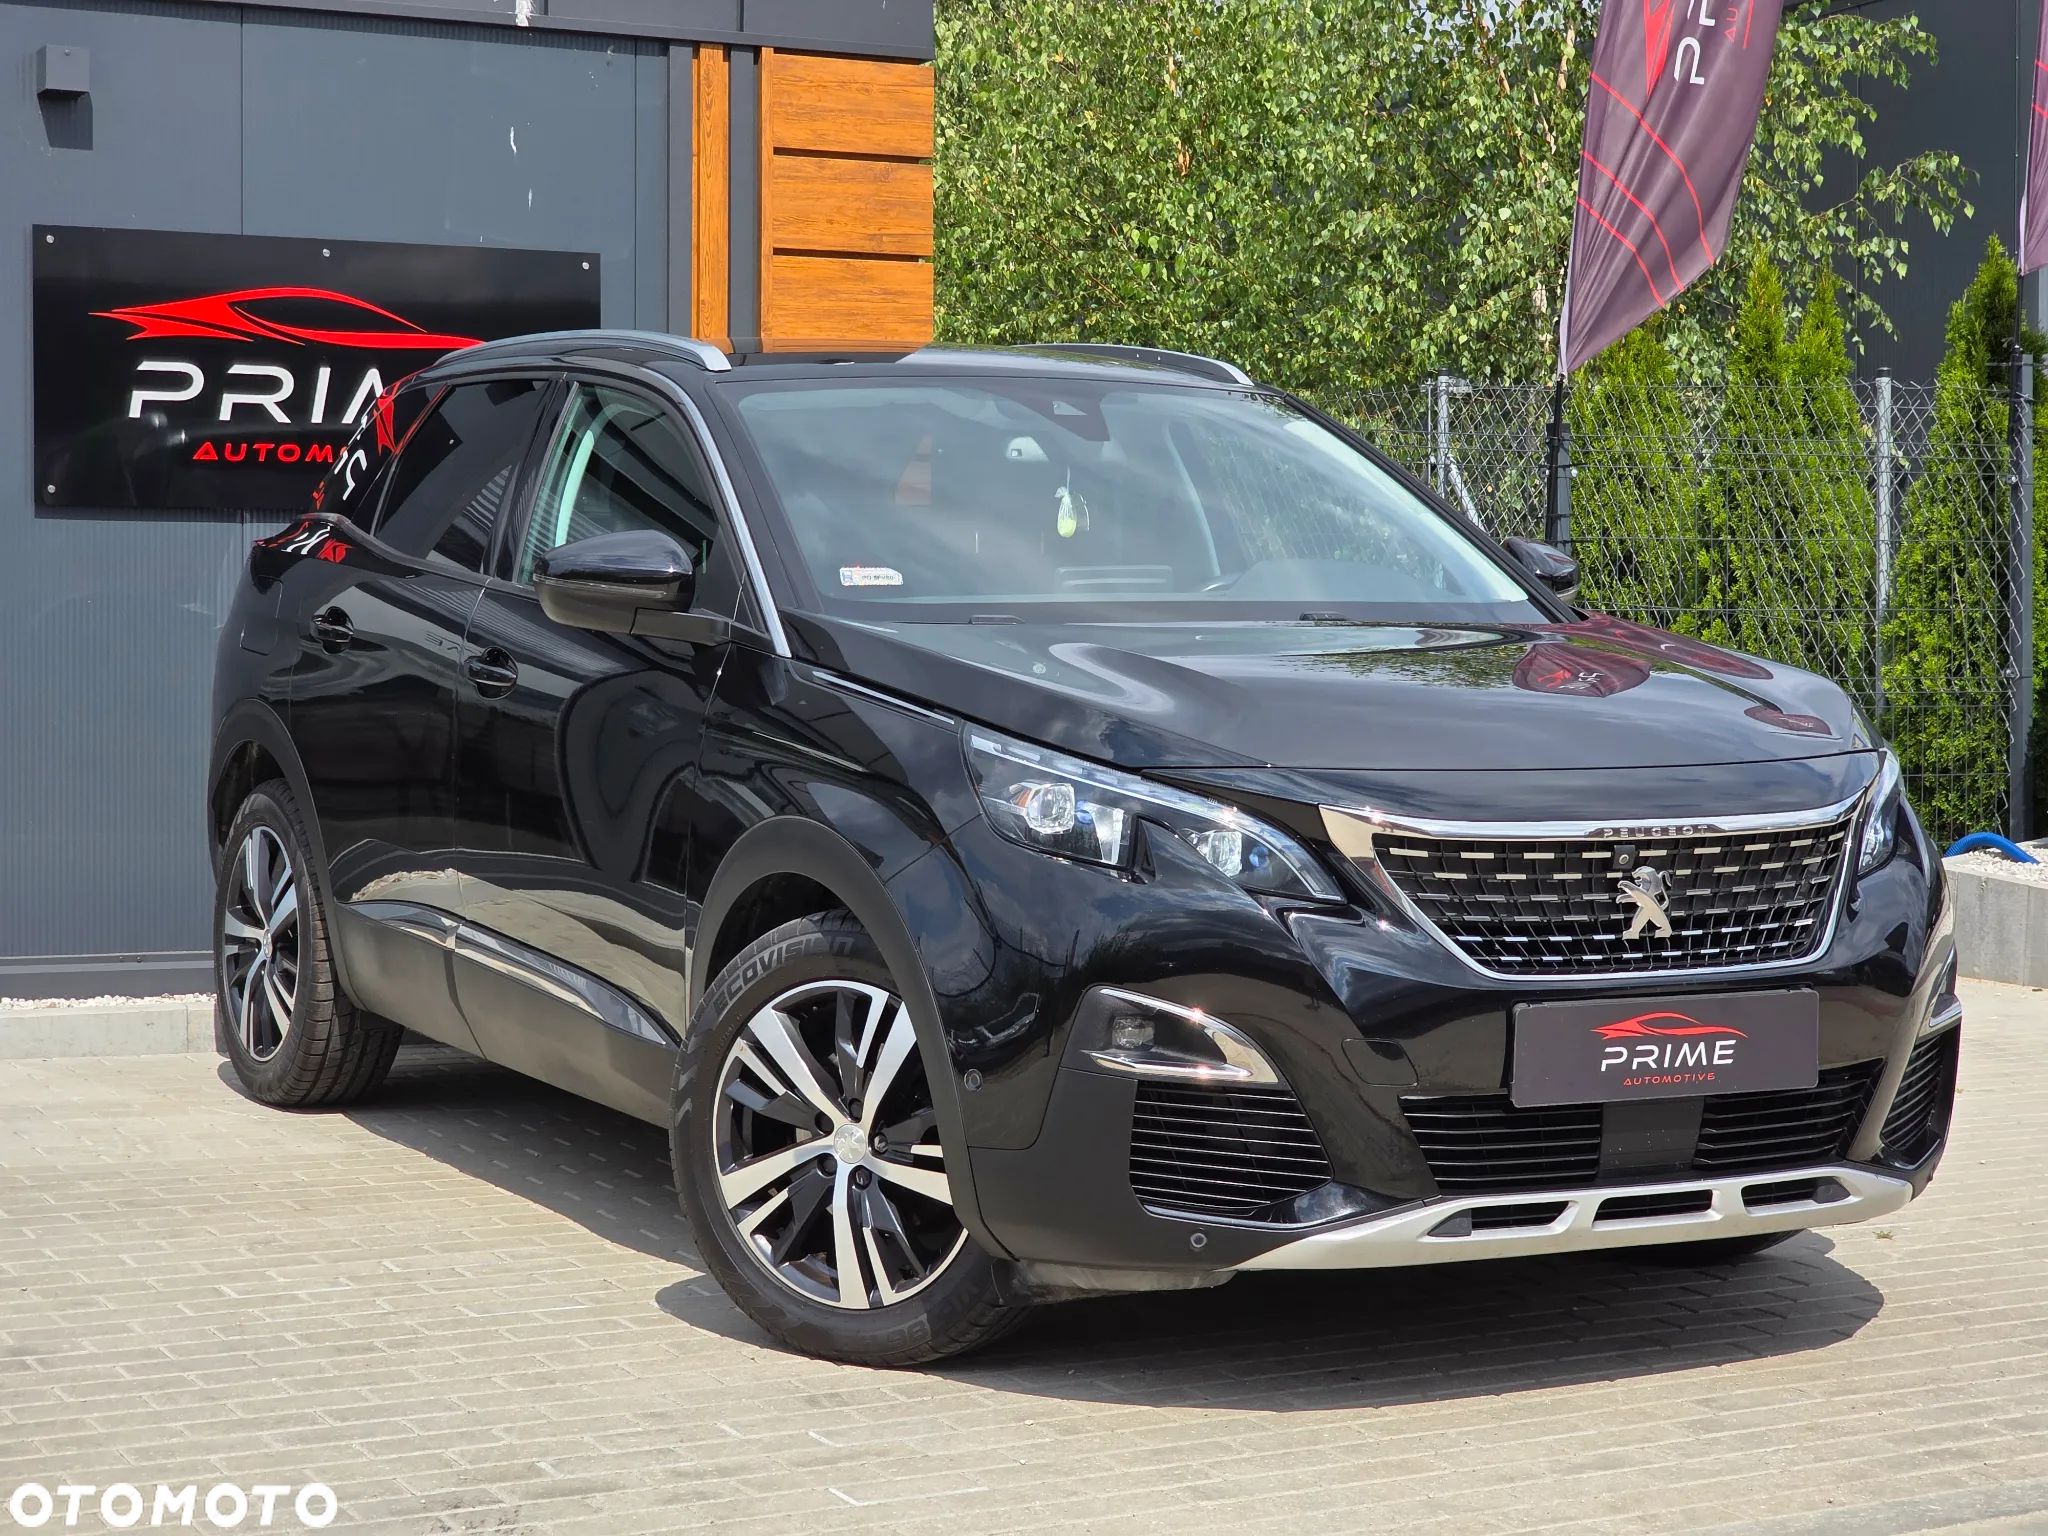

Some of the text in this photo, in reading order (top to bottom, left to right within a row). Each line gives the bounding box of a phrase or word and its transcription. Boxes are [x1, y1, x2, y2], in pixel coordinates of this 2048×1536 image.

[192, 441, 347, 463] AUTOM
[1602, 824, 1709, 838] PEUGEOT
[1600, 1040, 1737, 1072] PRIME
[1623, 1072, 1716, 1086] AUTOMOTIVE
